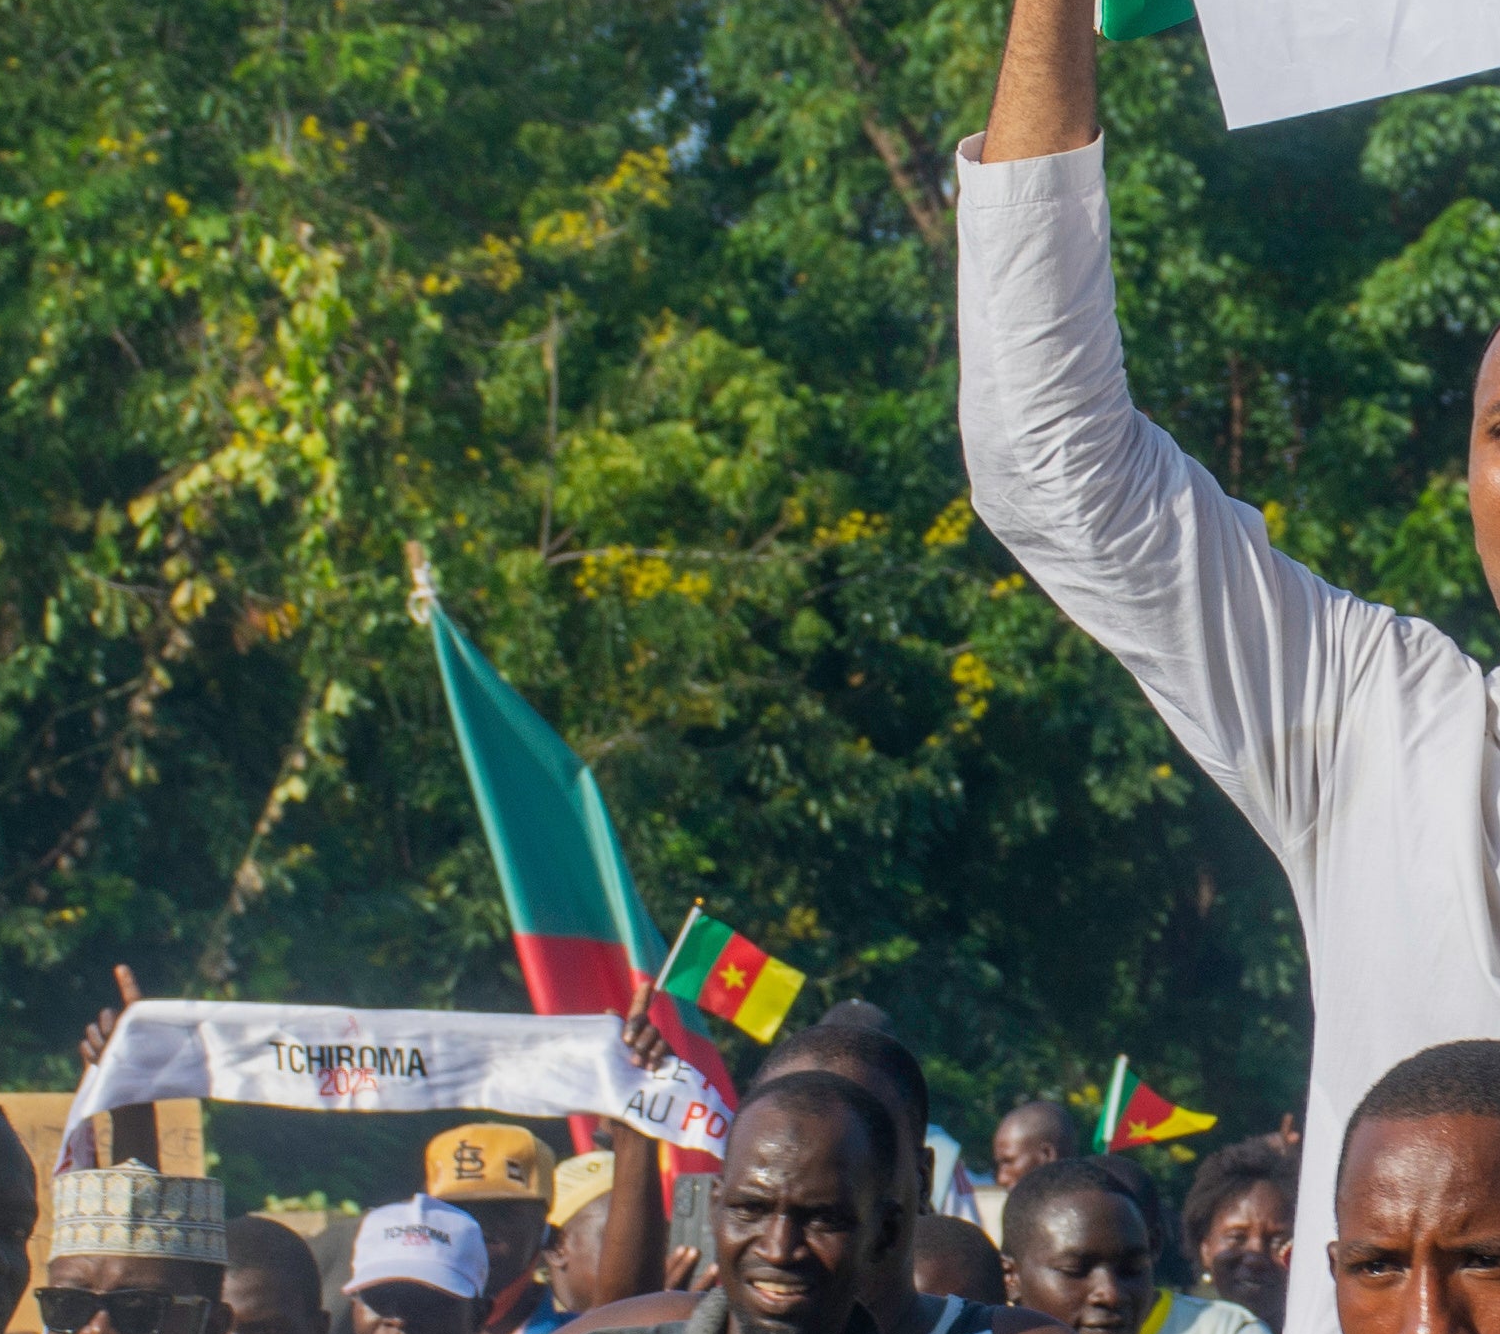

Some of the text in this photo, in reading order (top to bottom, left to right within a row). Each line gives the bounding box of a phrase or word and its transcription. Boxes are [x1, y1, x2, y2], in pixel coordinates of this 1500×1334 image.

[269, 1041, 428, 1076] TCHIROMA
[318, 1066, 378, 1097] 2025
[623, 1088, 674, 1123] AU
